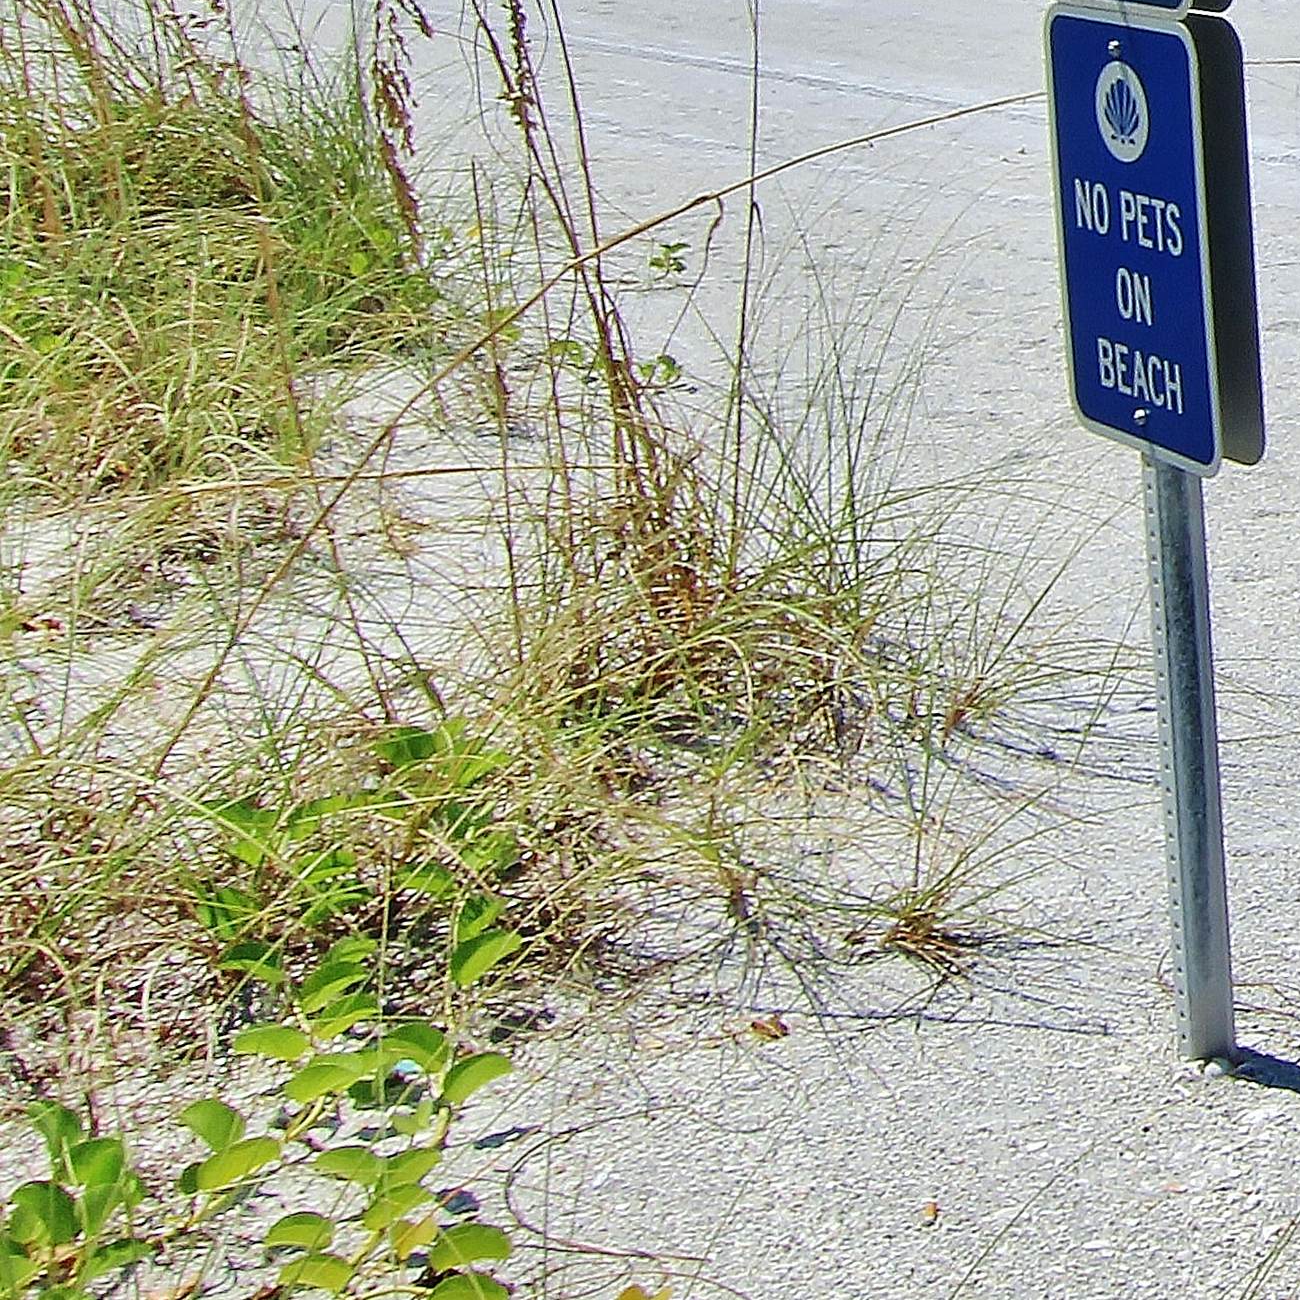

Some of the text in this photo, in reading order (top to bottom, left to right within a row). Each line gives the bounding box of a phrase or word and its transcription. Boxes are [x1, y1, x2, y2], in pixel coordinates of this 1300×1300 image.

[1074, 178, 1183, 257] NO PETS
[1116, 267, 1153, 327] ON
[1097, 338, 1184, 415] BEACH
